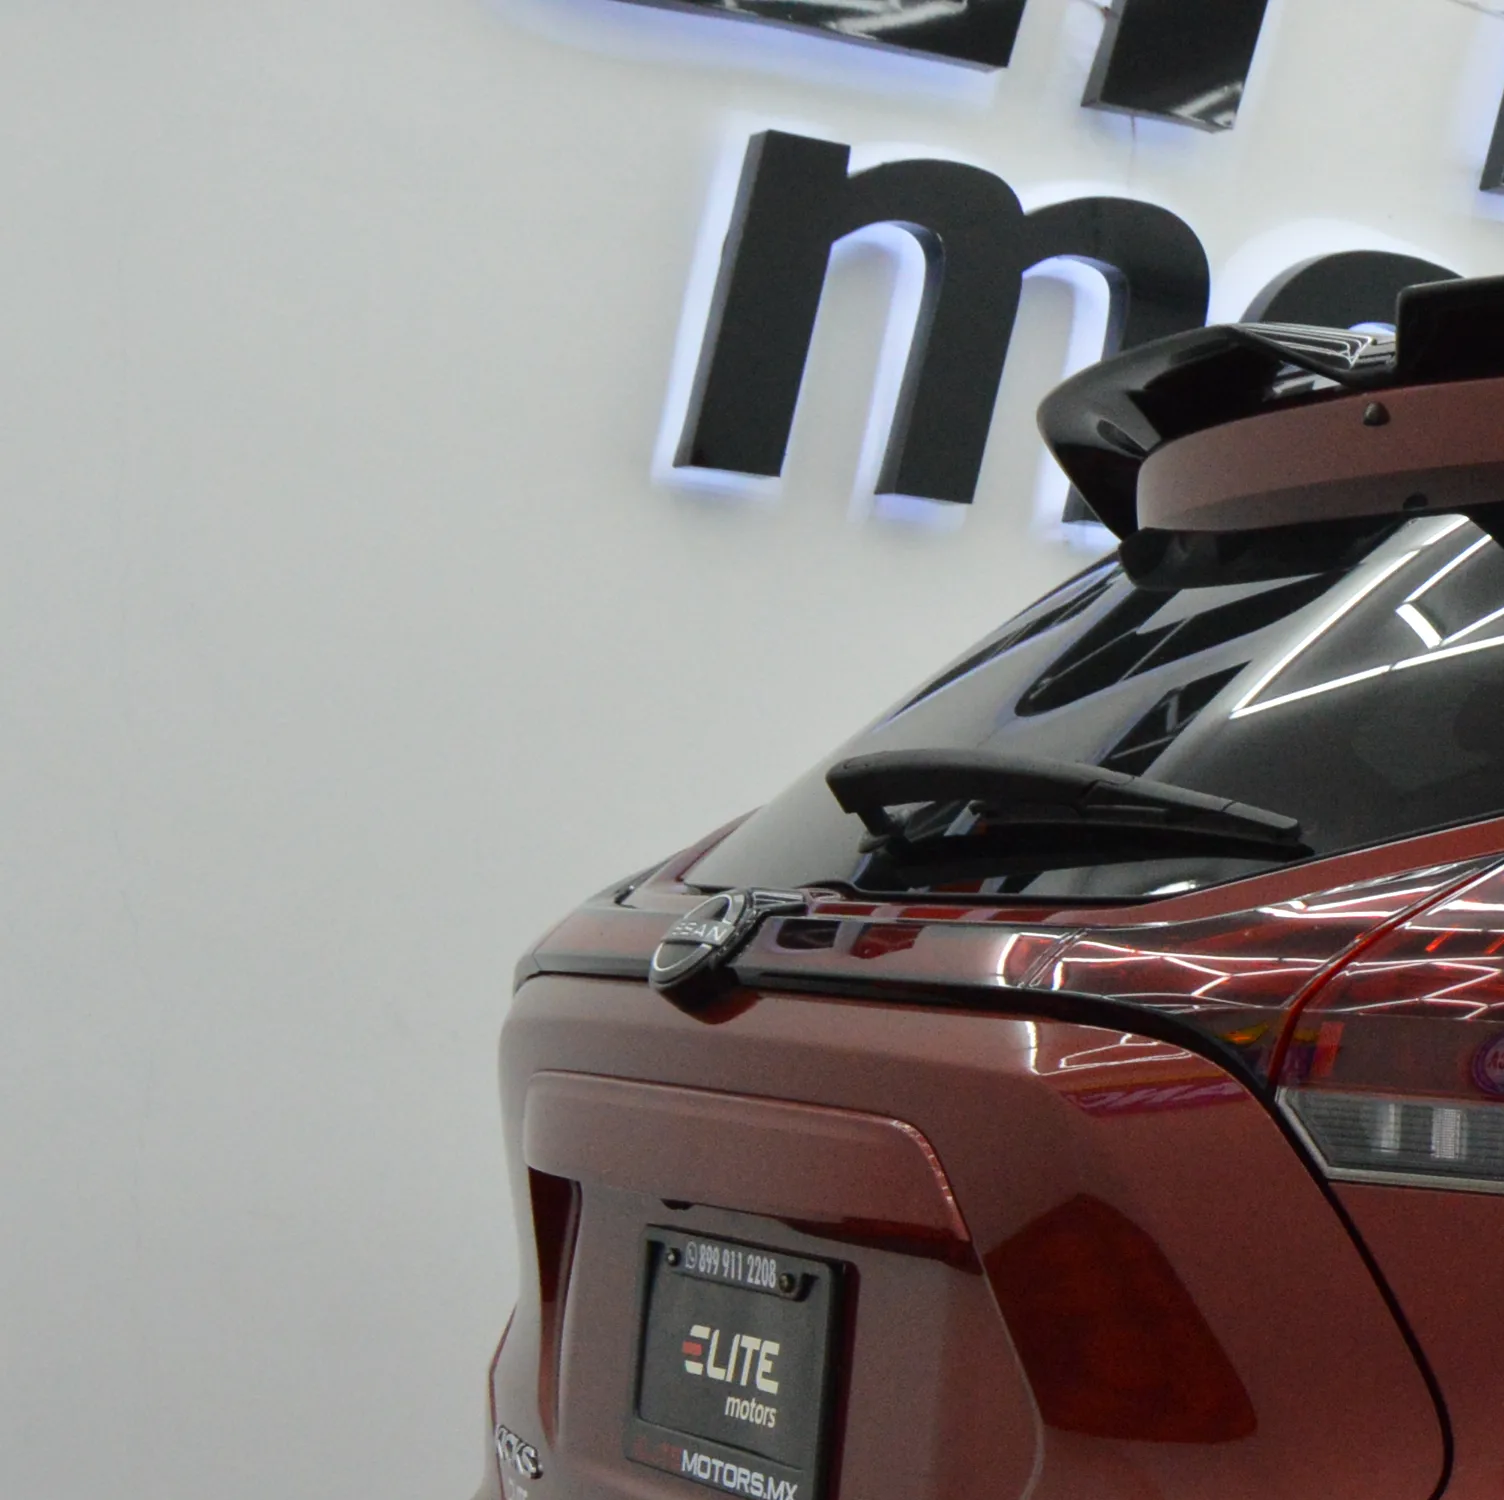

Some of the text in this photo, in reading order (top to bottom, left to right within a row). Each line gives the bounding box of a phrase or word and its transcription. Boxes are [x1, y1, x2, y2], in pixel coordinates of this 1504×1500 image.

[698, 1243, 777, 1288] 899 911 2208
[681, 1324, 780, 1395] ELITE
[724, 1396, 776, 1428] motors
